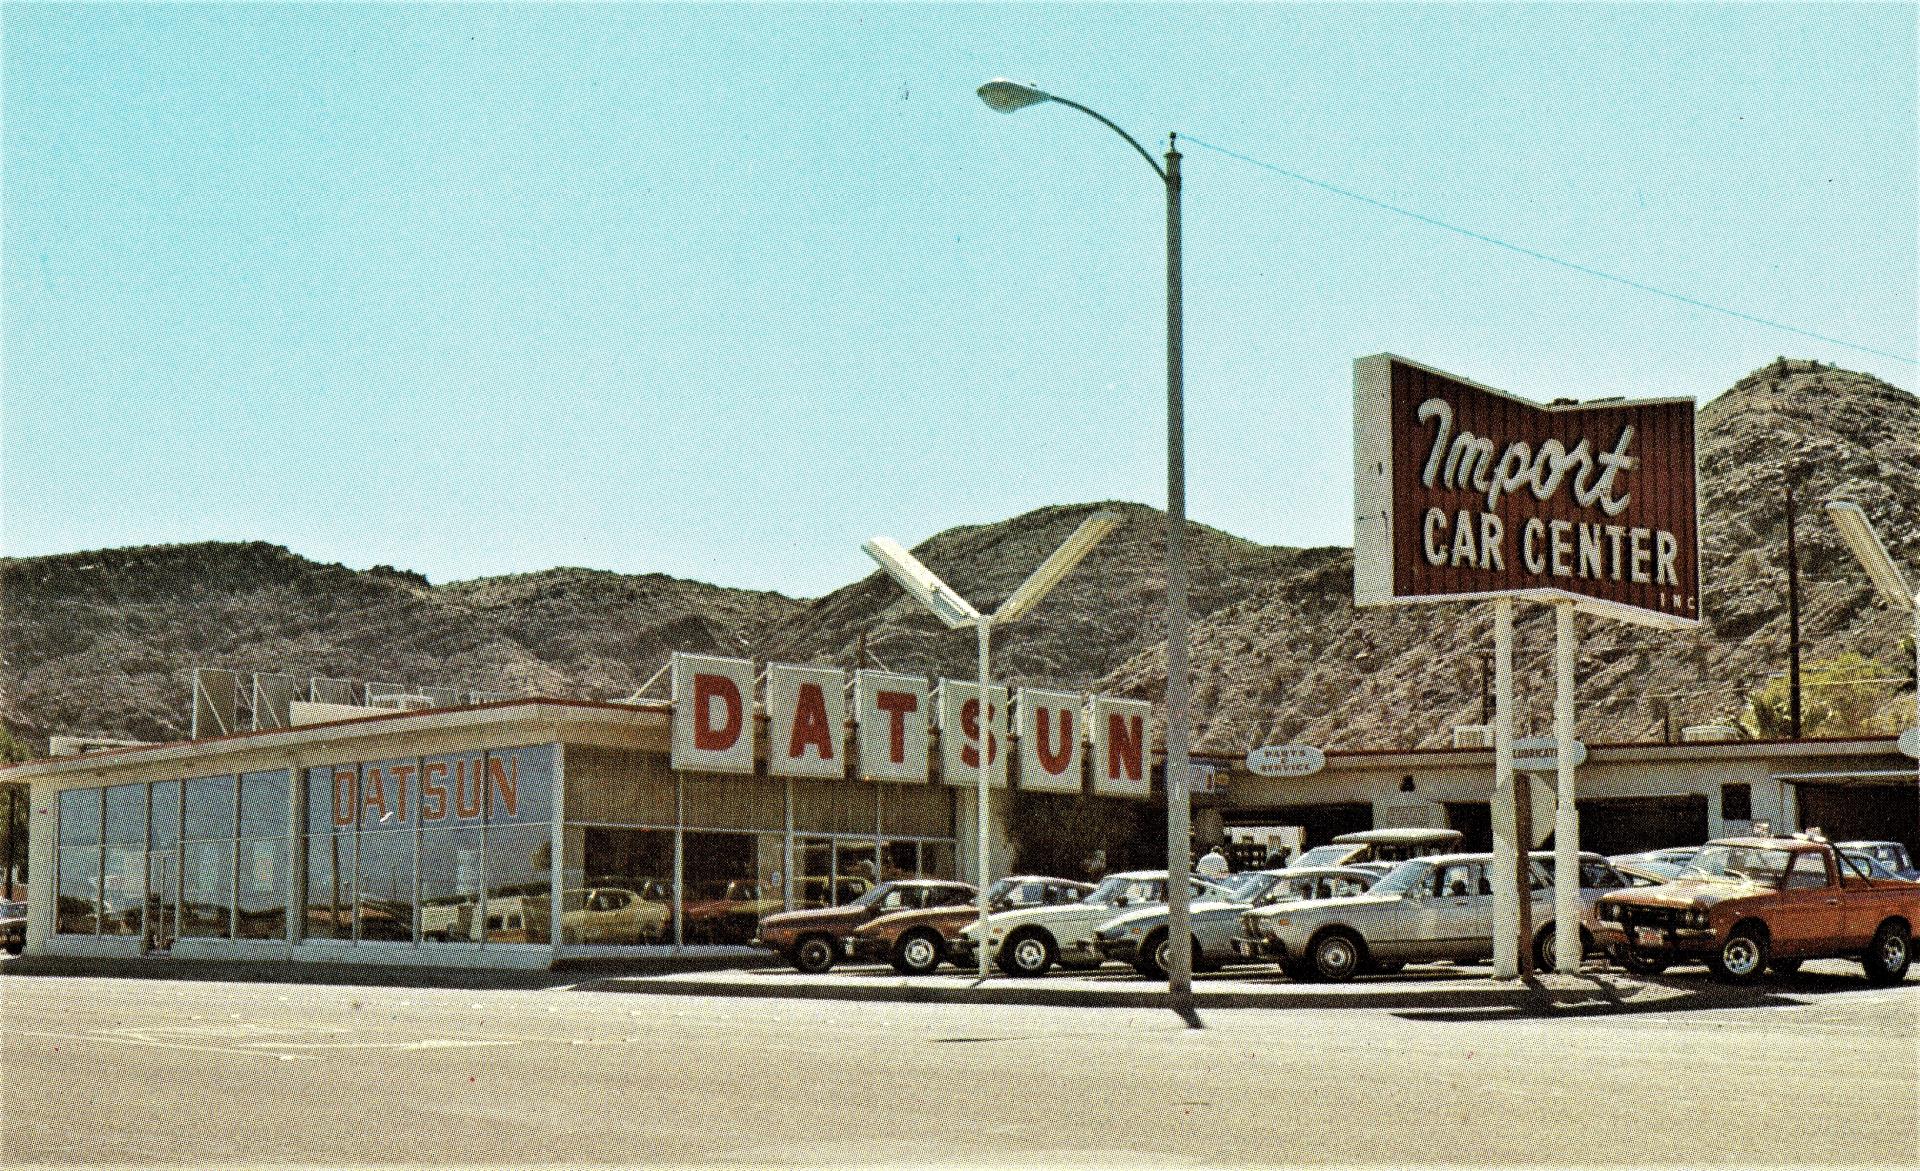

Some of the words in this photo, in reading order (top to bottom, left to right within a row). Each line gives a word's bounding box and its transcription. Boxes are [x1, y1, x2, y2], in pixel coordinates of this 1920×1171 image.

[1417, 397, 1641, 517] Import
[1422, 506, 1506, 572] CAR
[1523, 517, 1680, 587] CENTER
[693, 672, 1144, 781] DATSUN
[332, 755, 519, 827] DATSUN
